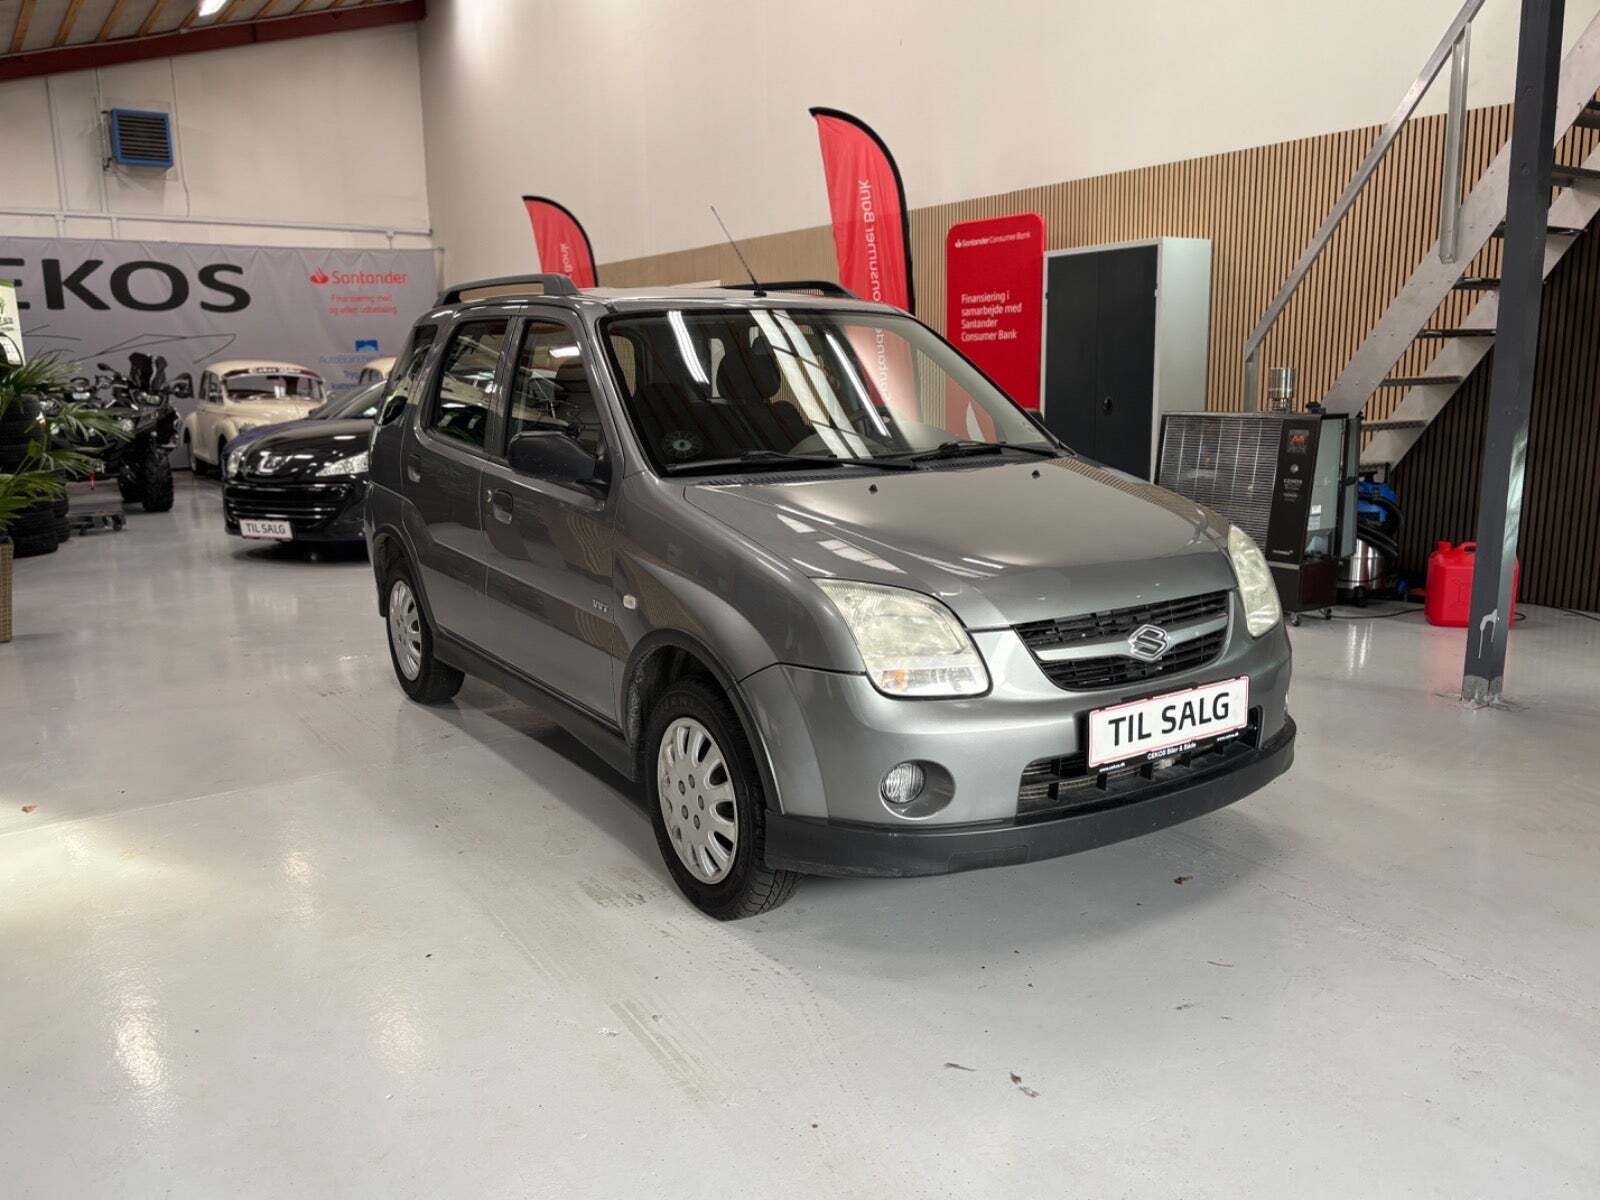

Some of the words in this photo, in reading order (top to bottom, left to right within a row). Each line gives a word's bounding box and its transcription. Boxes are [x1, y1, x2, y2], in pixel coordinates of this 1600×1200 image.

[331, 270, 408, 285] Santander
[961, 291, 1006, 304] Finansiering
[961, 305, 1004, 317] samarbejde
[1004, 302, 1023, 313] med
[961, 318, 998, 329] Santander
[961, 331, 997, 342] Consumer
[997, 329, 1017, 340] Bank
[246, 524, 261, 534] TIL
[262, 524, 286, 534] SALG
[1108, 712, 1152, 747] TIL
[1161, 691, 1230, 735] SALG
